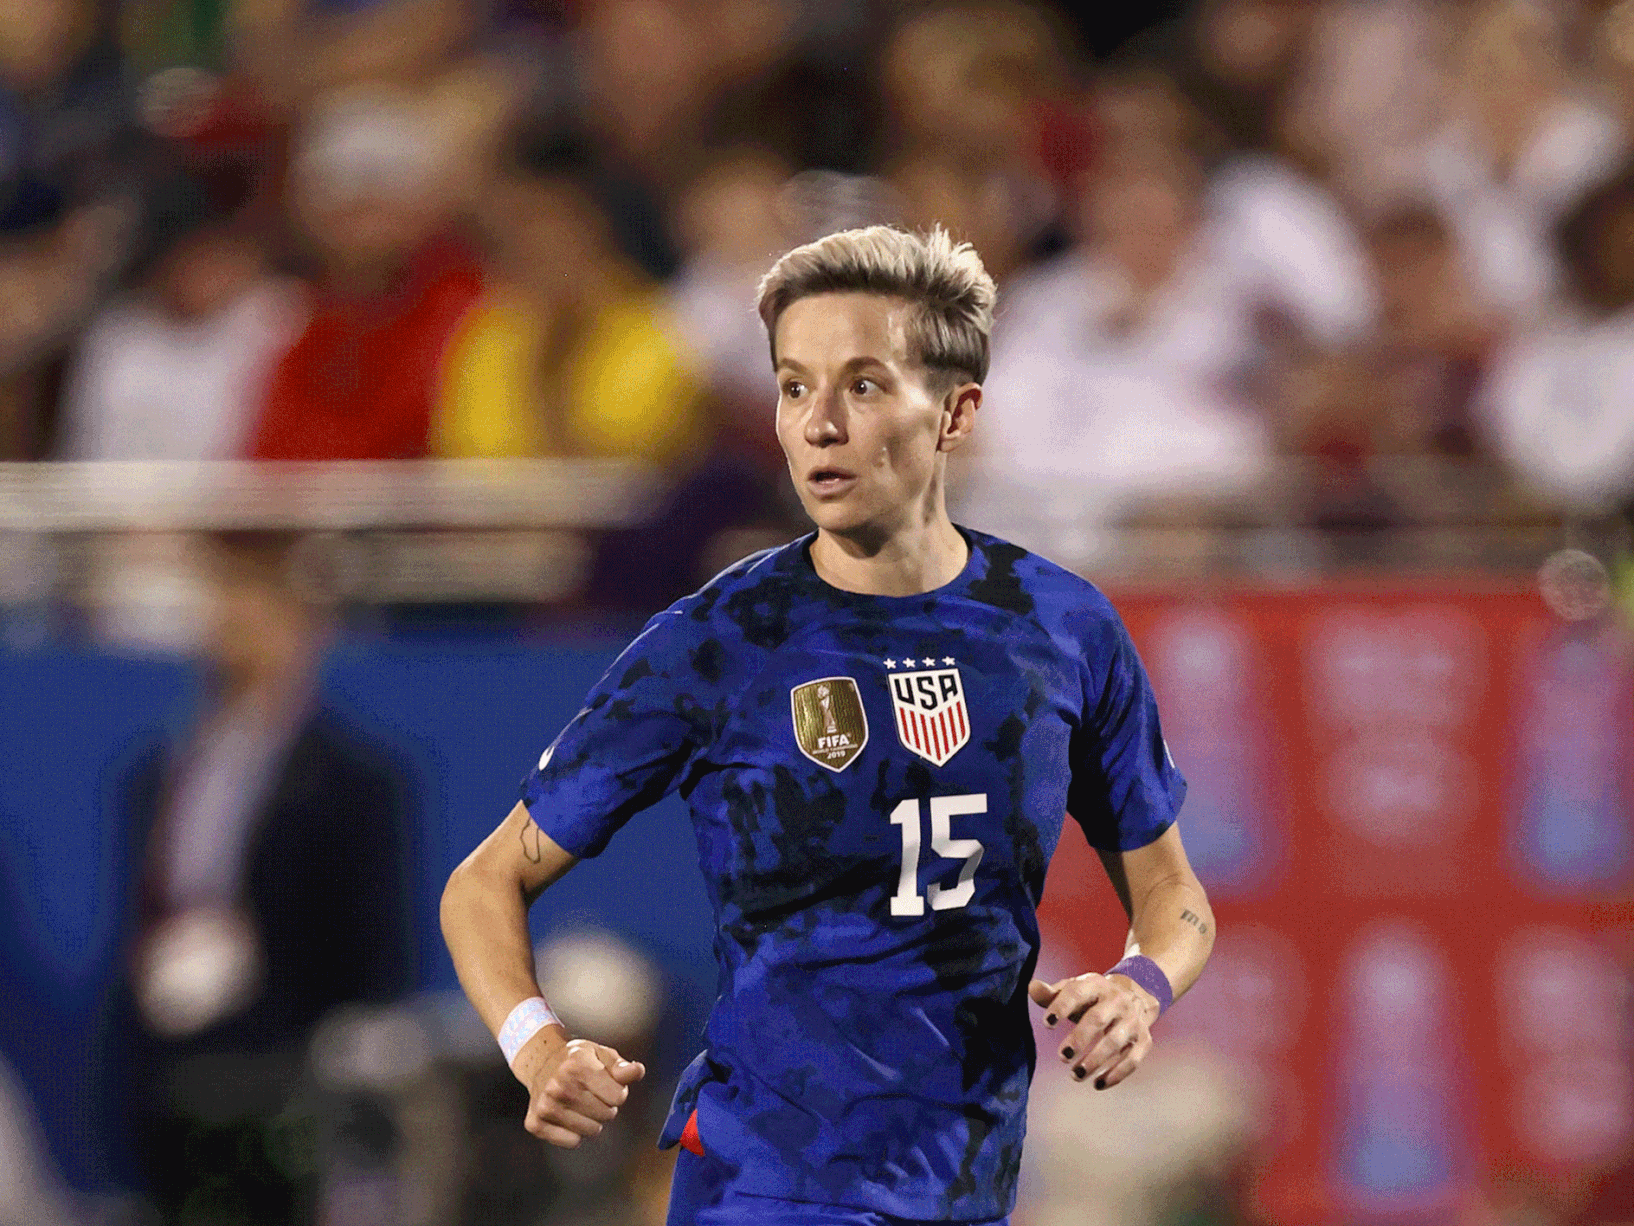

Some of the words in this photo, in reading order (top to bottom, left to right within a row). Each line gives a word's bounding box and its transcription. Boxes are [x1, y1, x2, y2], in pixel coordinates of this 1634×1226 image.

[894, 674, 958, 711] USA
[818, 733, 850, 749] FIFA
[890, 793, 987, 916] 15
